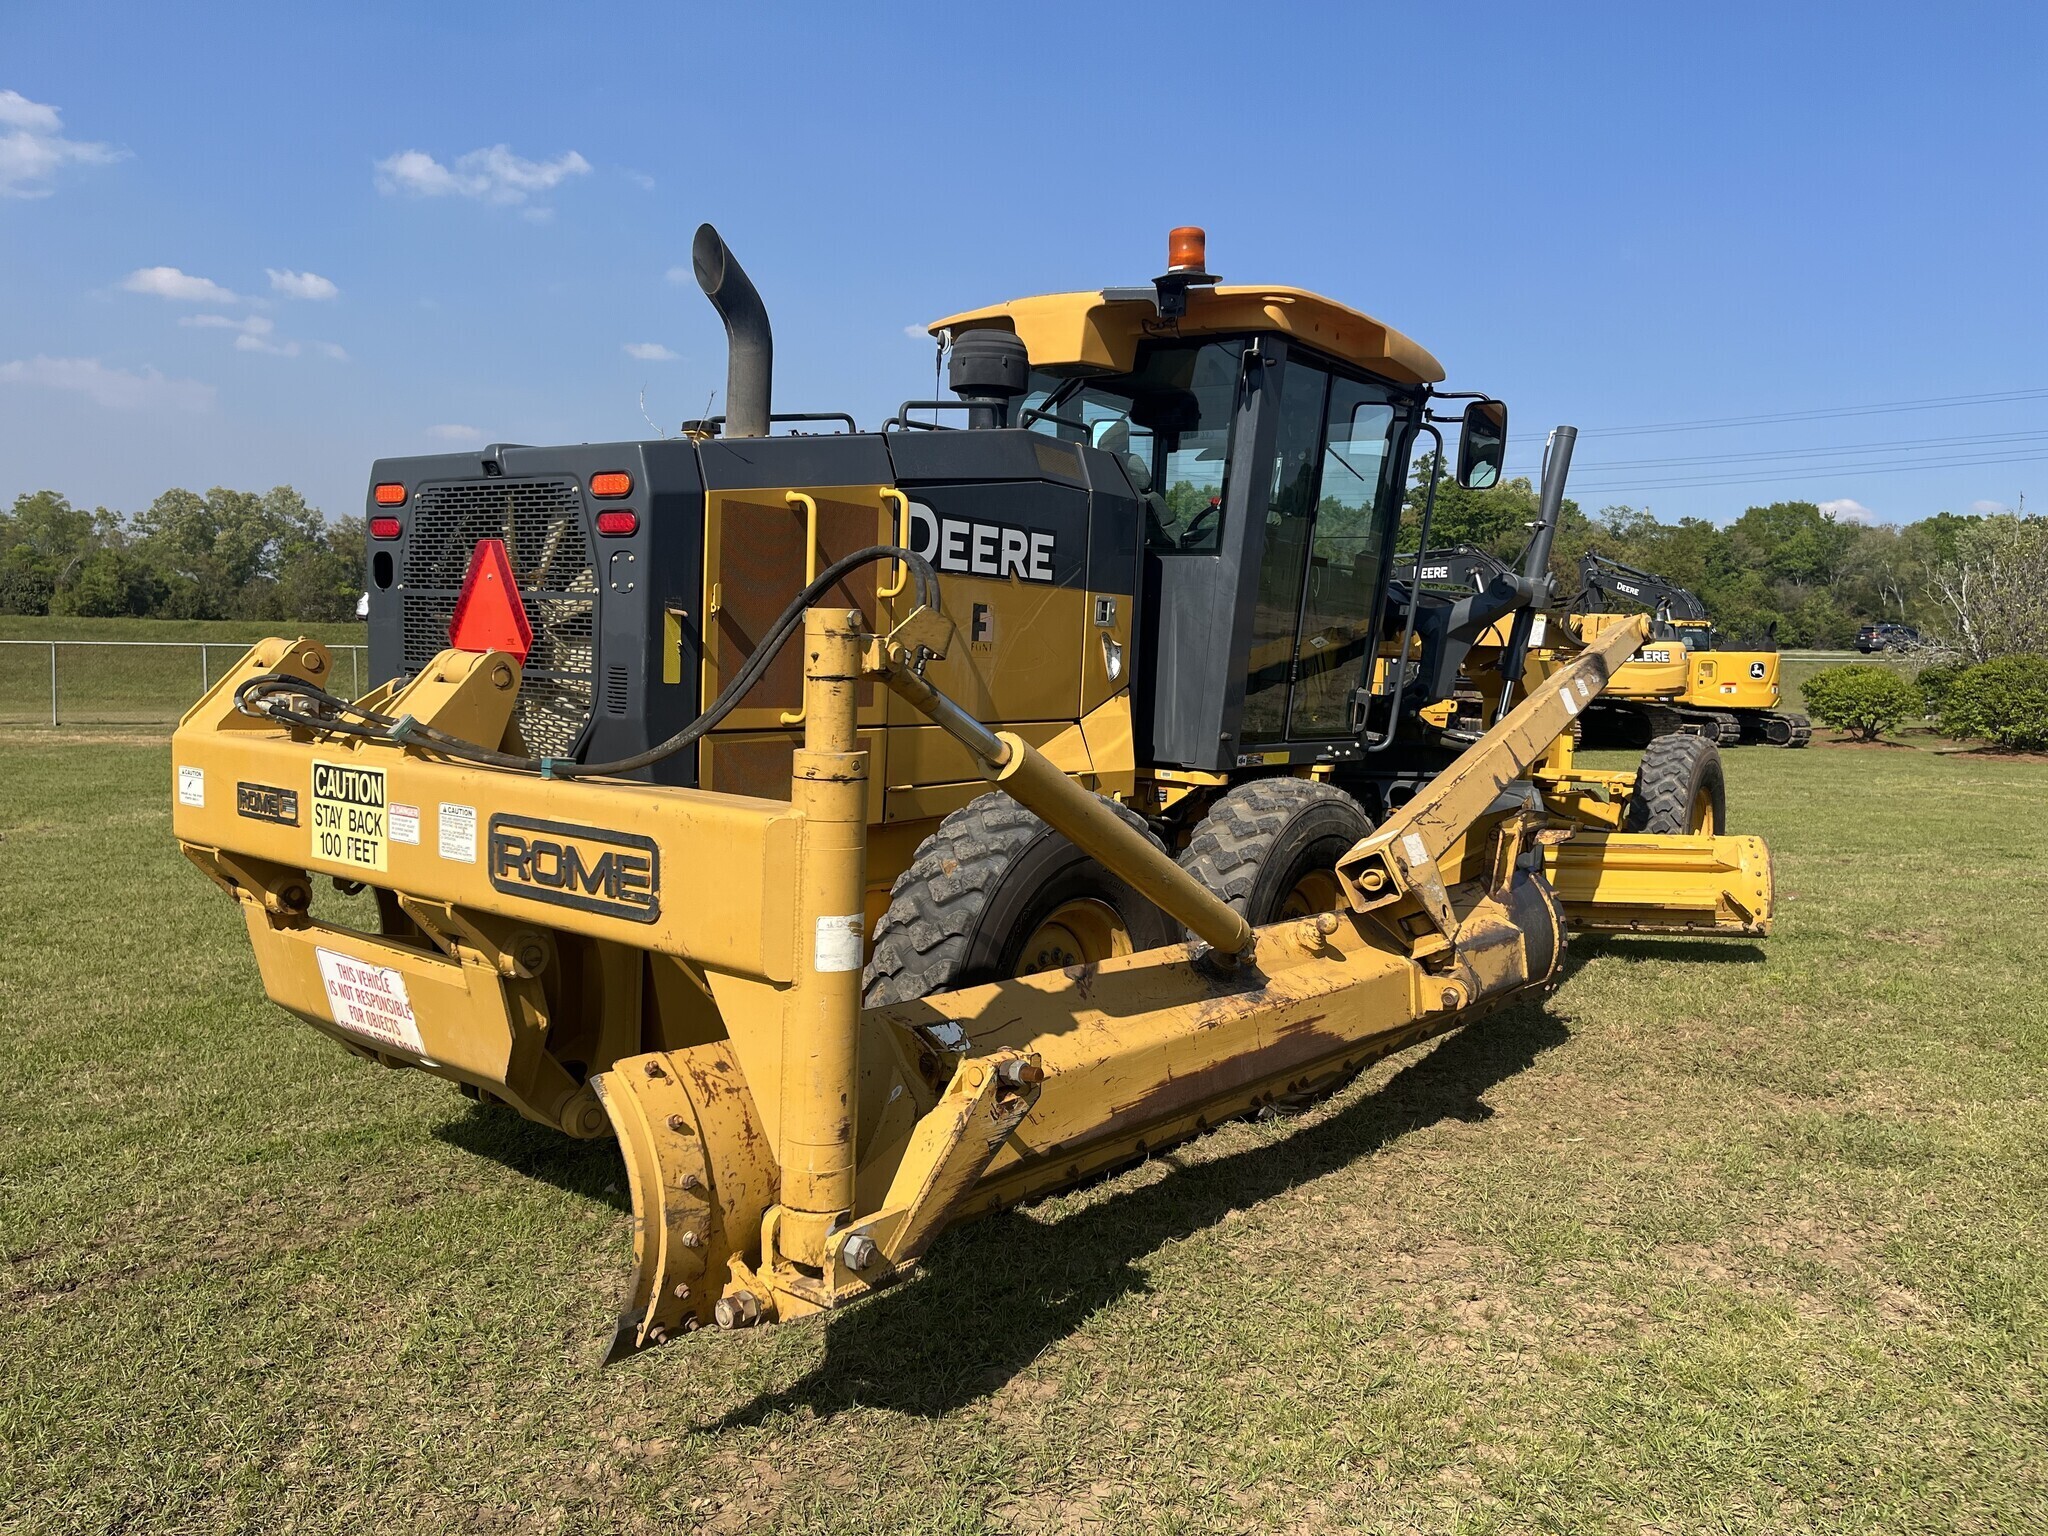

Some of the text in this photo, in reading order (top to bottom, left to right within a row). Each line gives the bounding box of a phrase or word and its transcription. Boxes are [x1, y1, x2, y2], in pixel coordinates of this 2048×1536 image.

[908, 501, 1054, 580] DEERE
[1617, 582, 1640, 596] DEERE
[316, 766, 382, 804] CAUTION
[239, 788, 278, 817] ROME
[447, 807, 473, 817] CAUTION
[315, 803, 342, 829] STAY
[349, 809, 383, 837] BACK
[320, 831, 378, 864] 100 FEET
[494, 834, 650, 904] ROME
[336, 963, 392, 994] THIS VEHICLE
[328, 979, 412, 1020] IS NOT RESPONSIBLE
[348, 1005, 401, 1036] FOR OBJECTS
